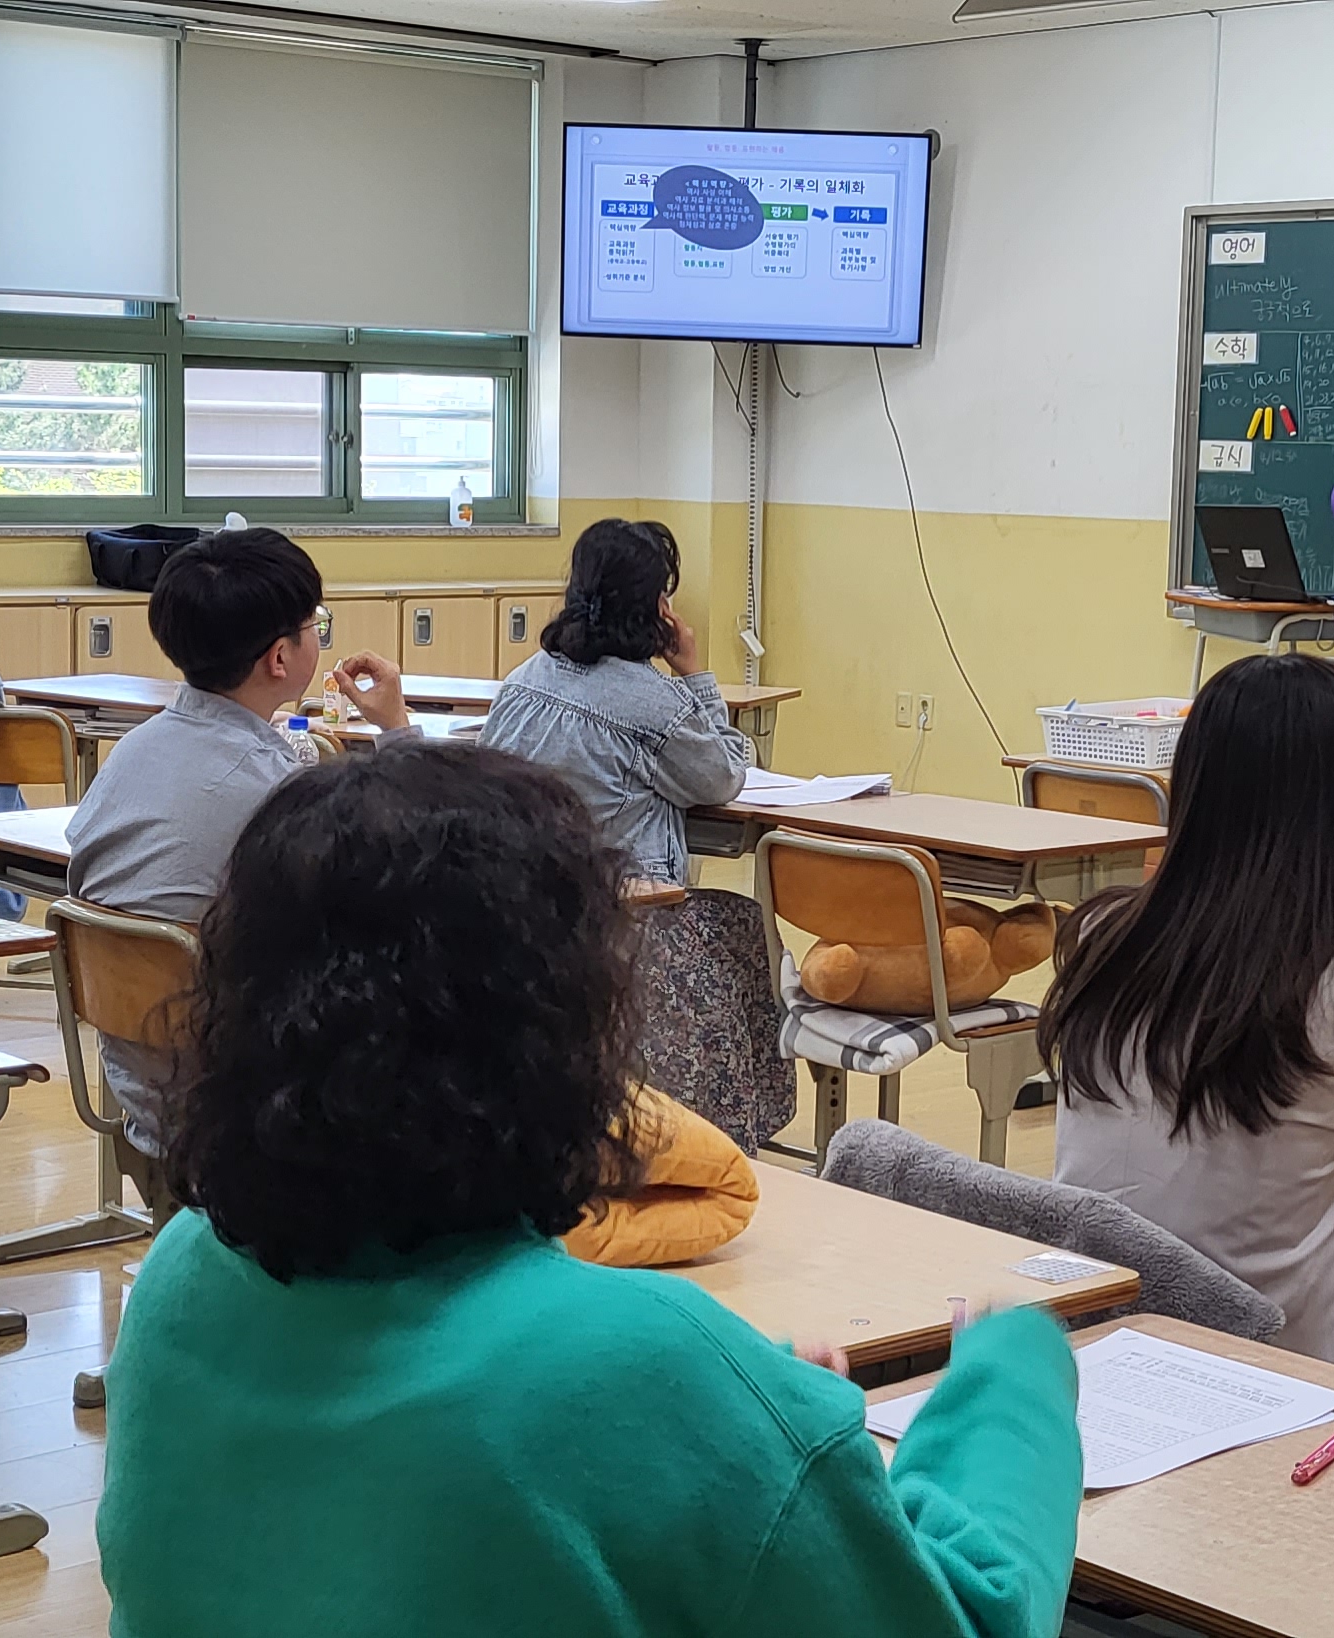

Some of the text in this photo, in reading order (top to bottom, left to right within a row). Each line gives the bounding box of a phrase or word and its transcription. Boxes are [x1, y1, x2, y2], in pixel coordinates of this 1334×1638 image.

[780, 178, 819, 194] 기록의
[825, 180, 865, 194] 일체화
[607, 203, 648, 215] 교육과정
[771, 206, 793, 219] 평가
[850, 209, 871, 222] 기록
[1222, 237, 1255, 260] 영어
[1215, 336, 1247, 360] 수학
[1211, 444, 1244, 468] 급식
